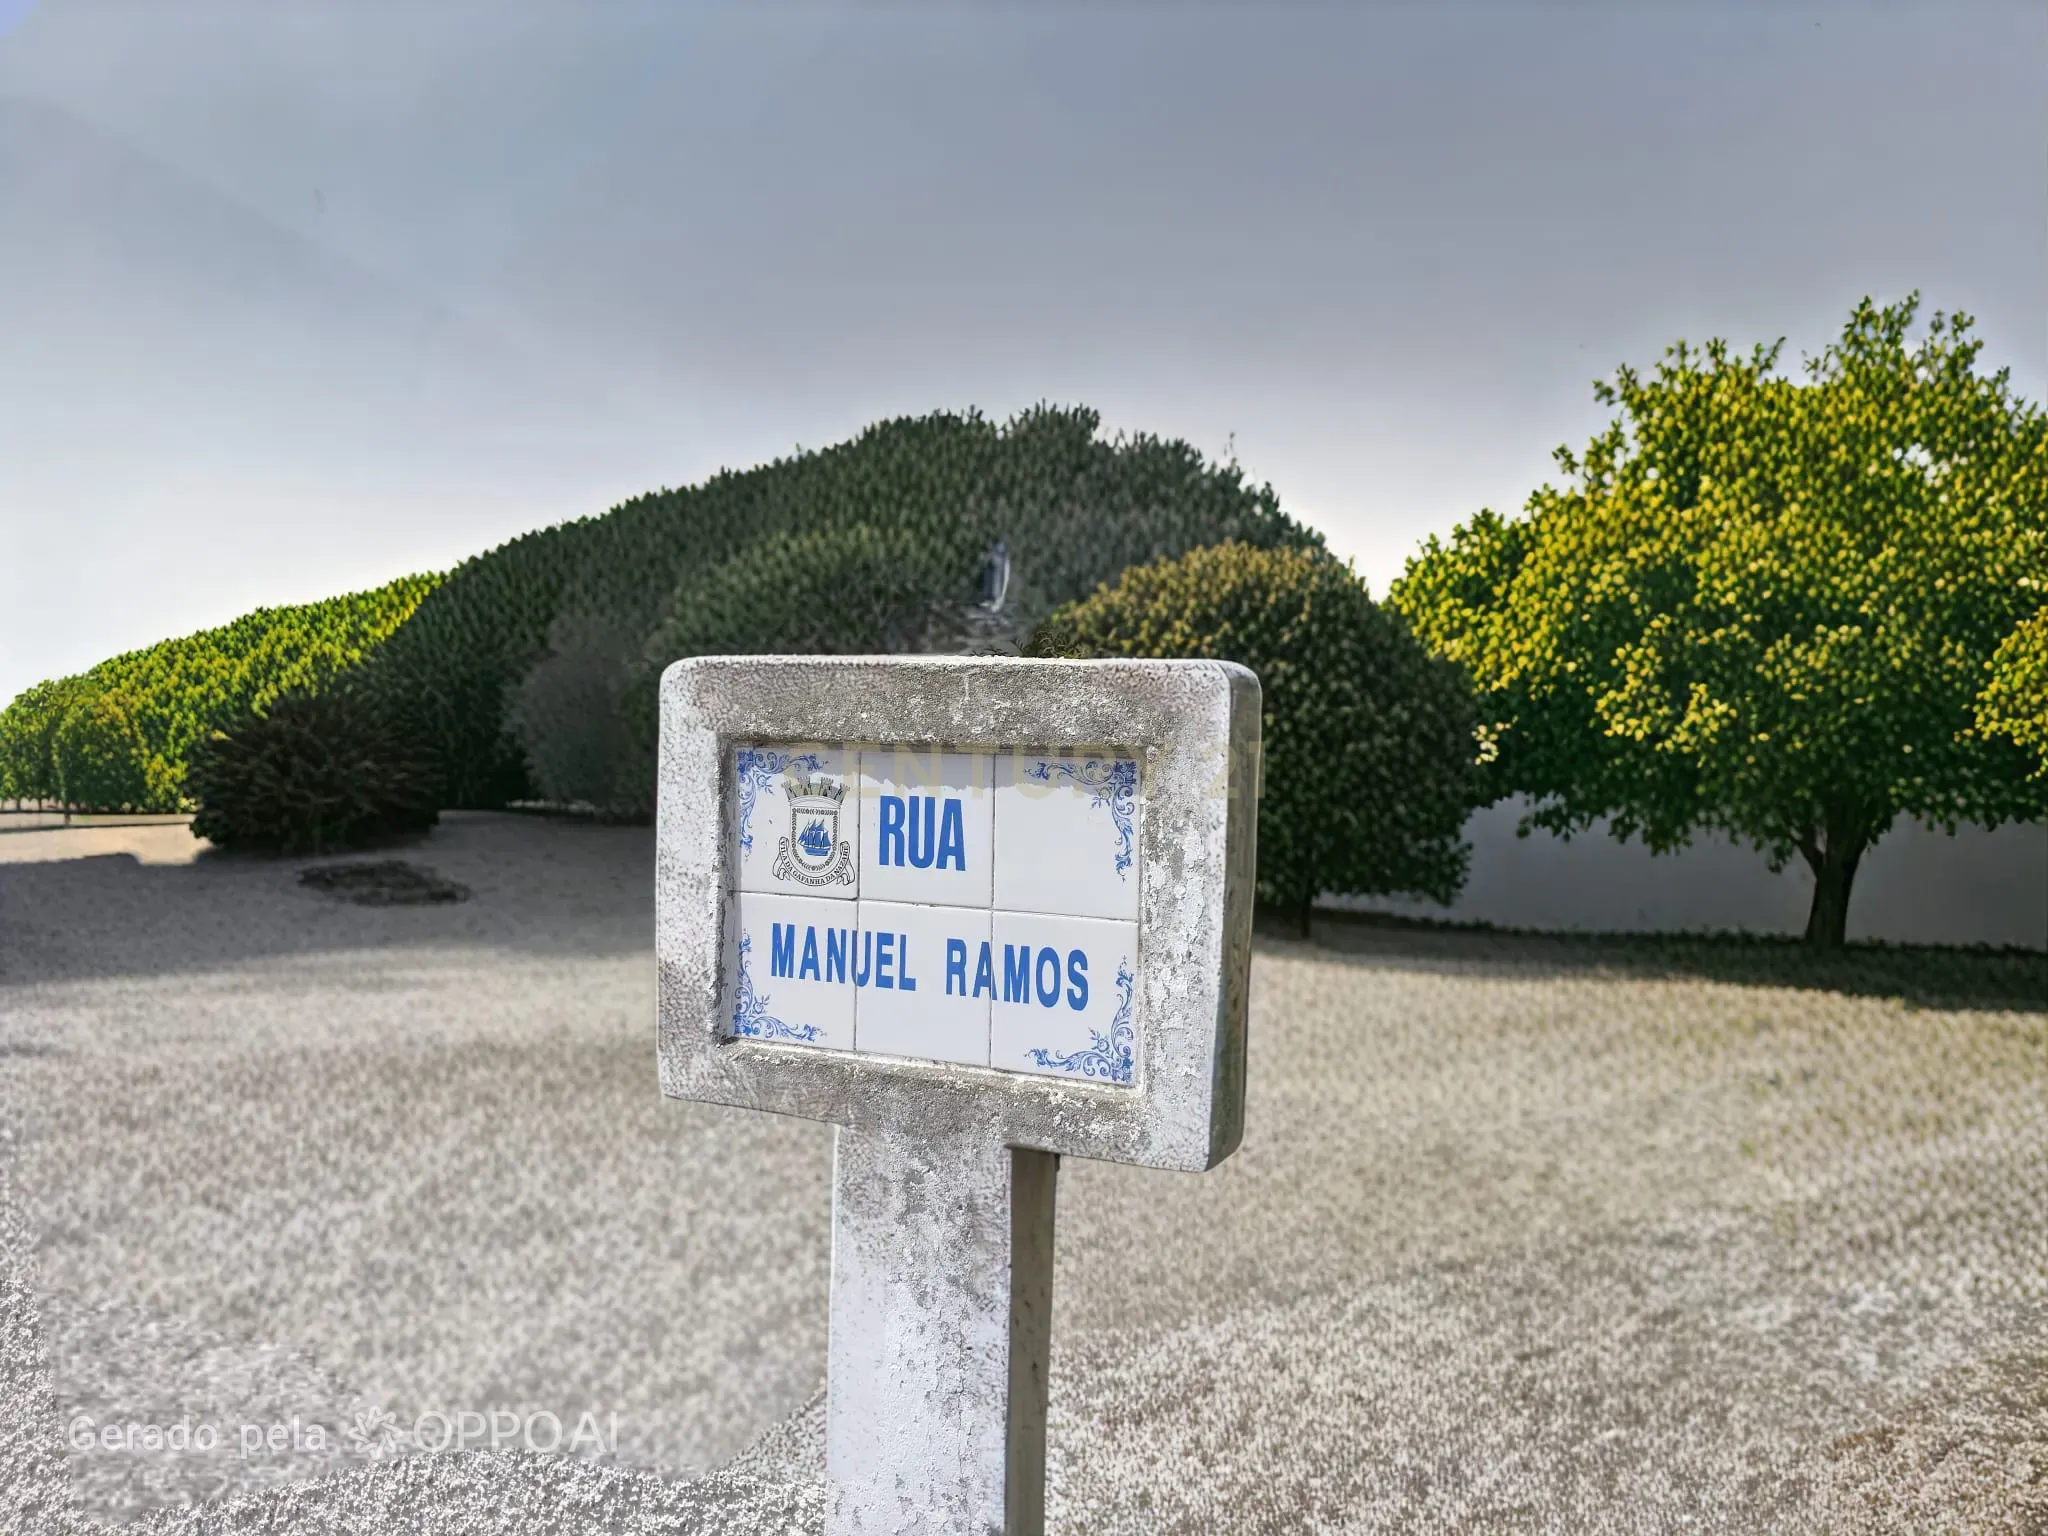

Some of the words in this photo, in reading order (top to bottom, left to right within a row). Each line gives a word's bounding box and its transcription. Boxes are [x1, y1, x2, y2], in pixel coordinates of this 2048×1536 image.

[780, 841, 788, 861] VILA
[785, 861, 793, 872] DA
[792, 871, 826, 885] GAFANHA
[825, 873, 836, 882] DA
[879, 795, 966, 872] RUA
[771, 922, 916, 991] MANUEL
[945, 938, 1089, 1011] RAMOS
